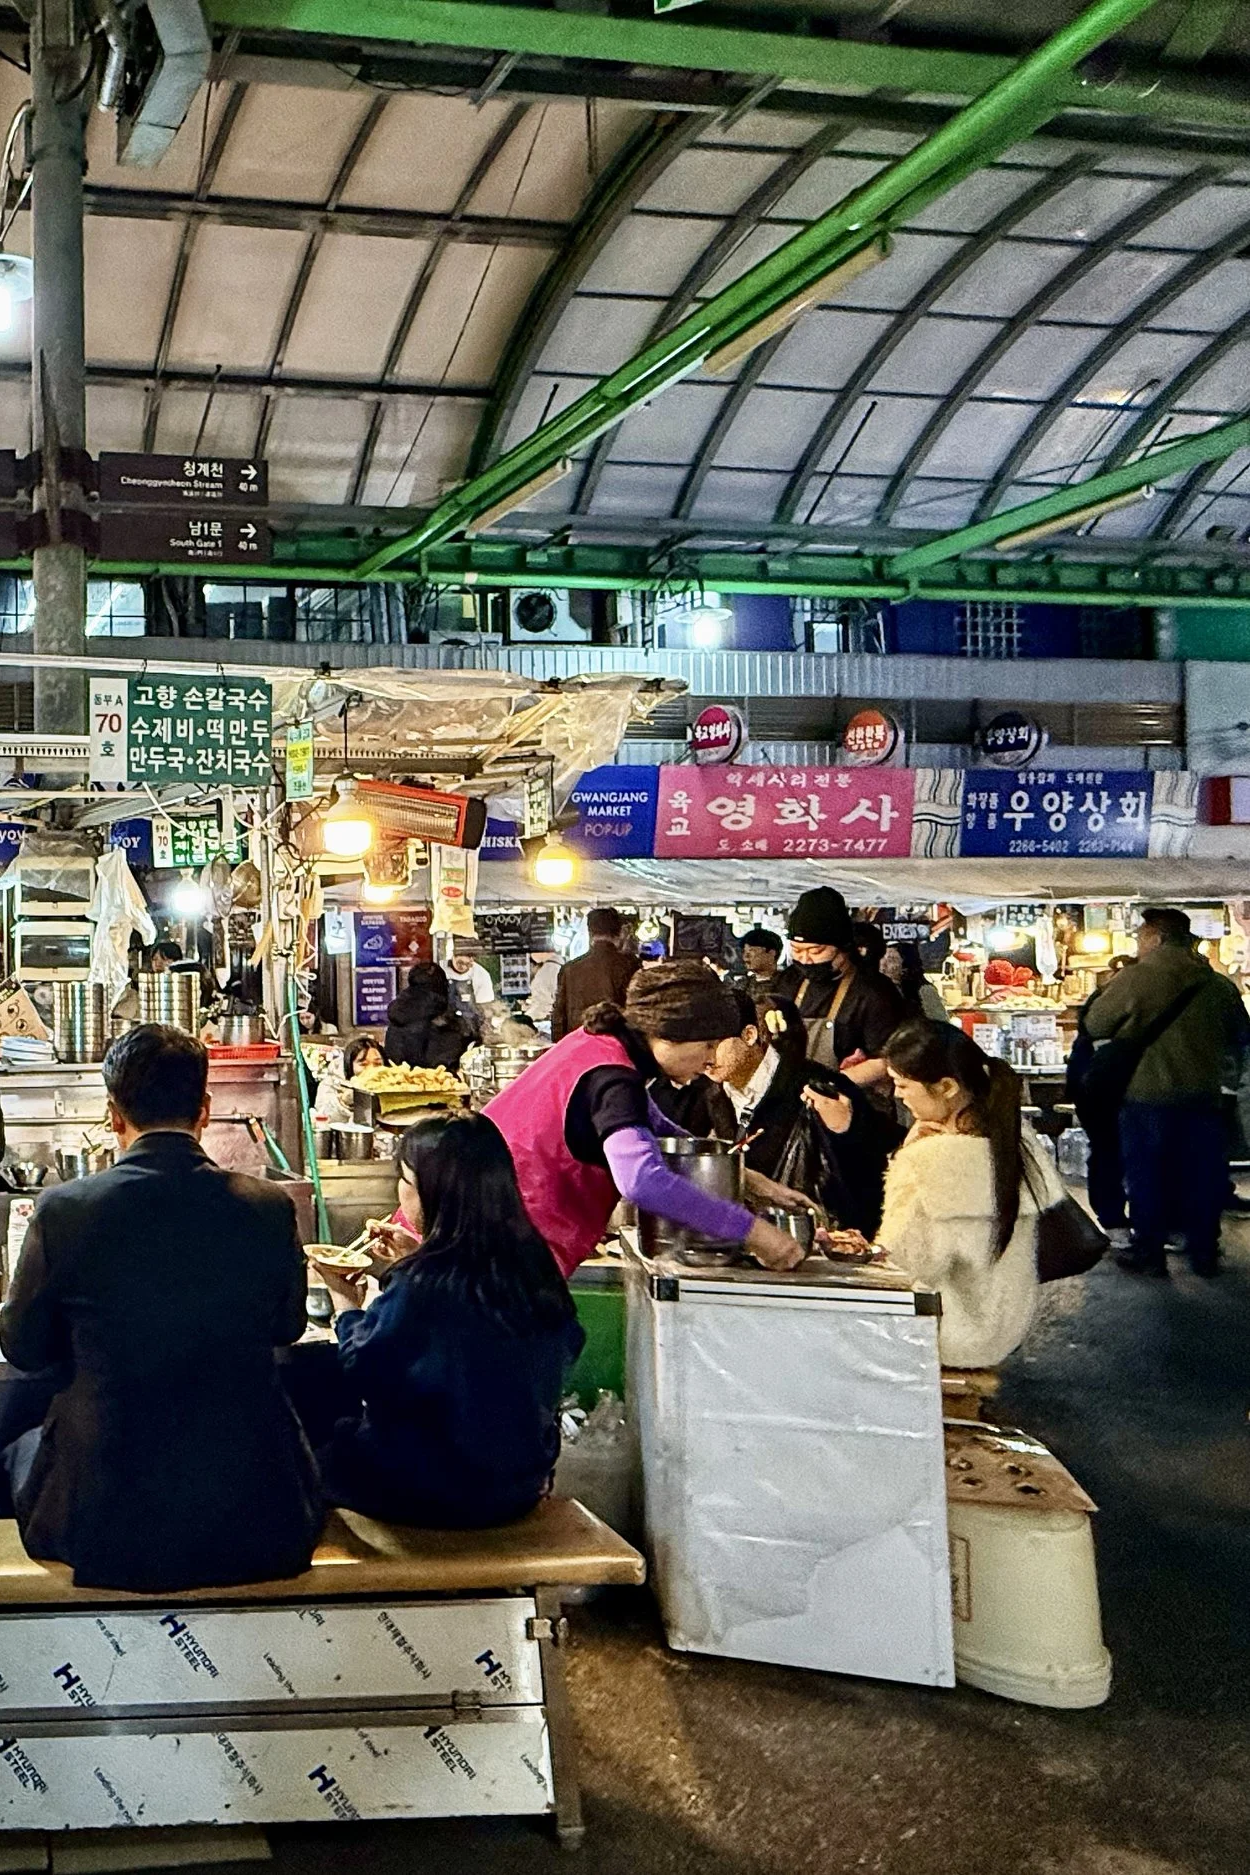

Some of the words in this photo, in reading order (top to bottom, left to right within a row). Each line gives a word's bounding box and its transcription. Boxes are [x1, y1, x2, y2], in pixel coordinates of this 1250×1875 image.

[182, 460, 224, 478] 청계천
[193, 479, 224, 490] Stream
[188, 521, 223, 536] 남1문
[169, 538, 195, 547] South
[196, 538, 216, 548] Gate
[93, 693, 112, 707] 동부
[114, 695, 124, 707] A
[133, 685, 178, 710] 고향
[182, 686, 269, 713] 손칼국수
[94, 713, 122, 733] 70
[100, 740, 116, 758] 호
[726, 772, 807, 788] 악세사리
[814, 773, 853, 788] 전문
[571, 792, 649, 803] GWANGJANG
[587, 805, 632, 817] MARKET
[706, 793, 900, 832] 영화사
[1002, 790, 1147, 833] 우양상회
[584, 823, 633, 837] POP-UP
[158, 836, 169, 846] 70
[740, 838, 769, 852] 소매
[783, 838, 888, 853] 2273-7477
[174, 1636, 202, 1673] STEEL
[183, 1631, 220, 1678] HYUNDAI
[262, 1652, 285, 1684] Leading
[430, 1737, 457, 1775] STEEL
[438, 1731, 477, 1781] HYUNDAI
[2, 1751, 32, 1789] STEEL
[12, 1745, 49, 1795] HYUNDAI
[93, 1766, 116, 1799] Leading
